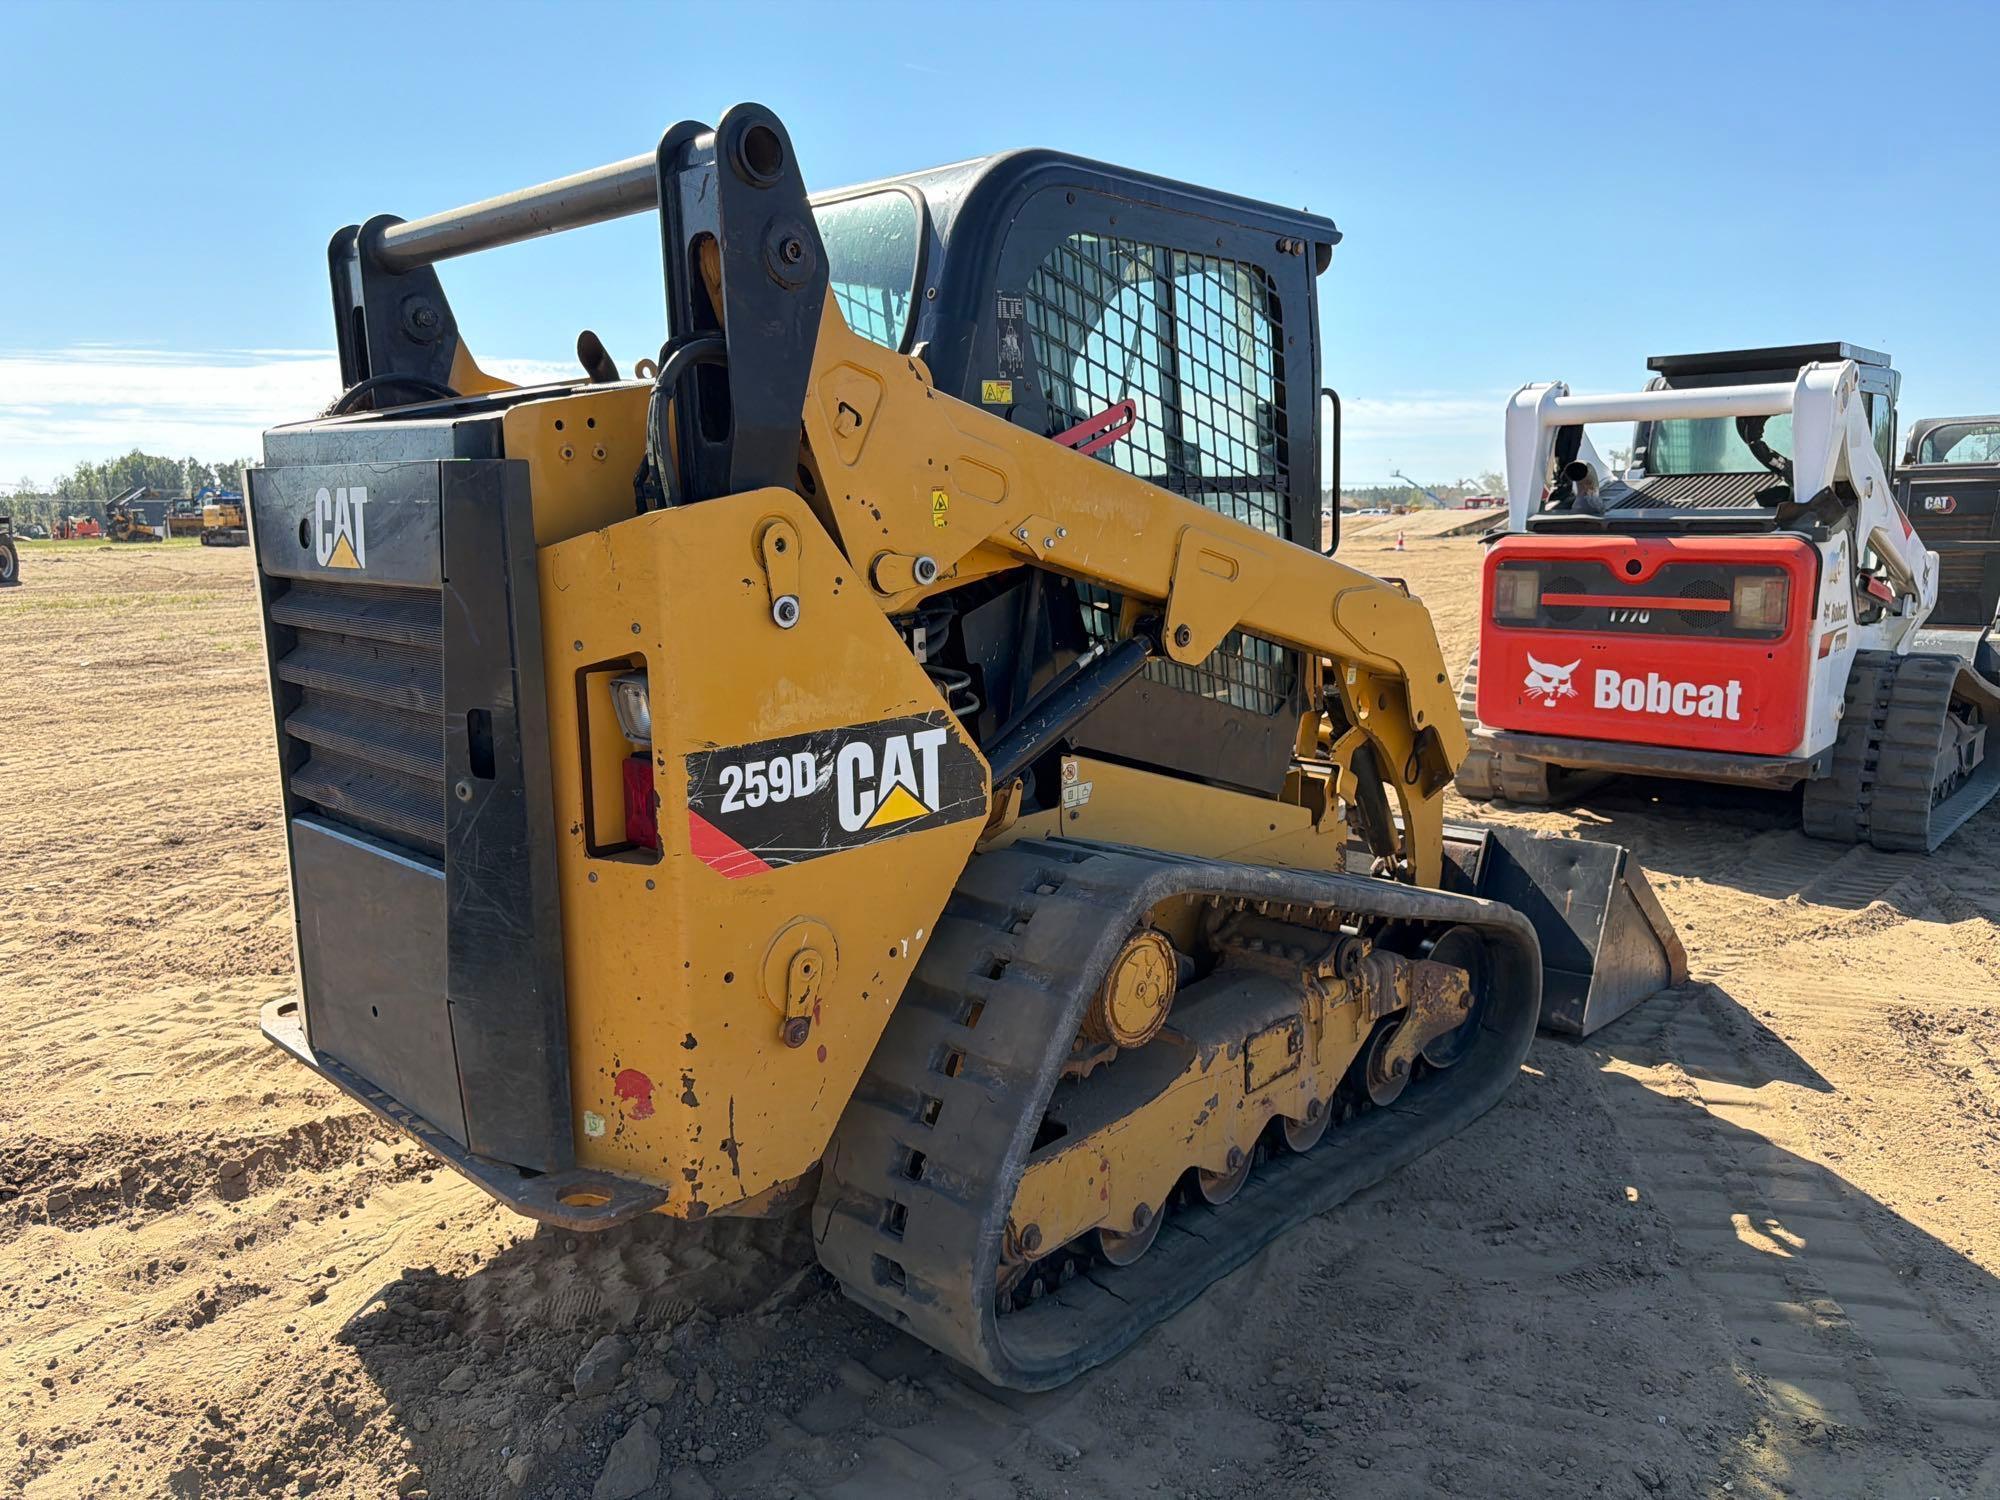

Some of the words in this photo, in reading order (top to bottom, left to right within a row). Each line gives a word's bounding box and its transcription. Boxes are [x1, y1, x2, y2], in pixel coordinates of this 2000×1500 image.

[315, 486, 367, 569] CAT
[1924, 496, 1949, 510] CAT
[1594, 668, 1742, 721] Bobcat
[719, 751, 817, 814] 259D
[836, 728, 948, 832] CAT
